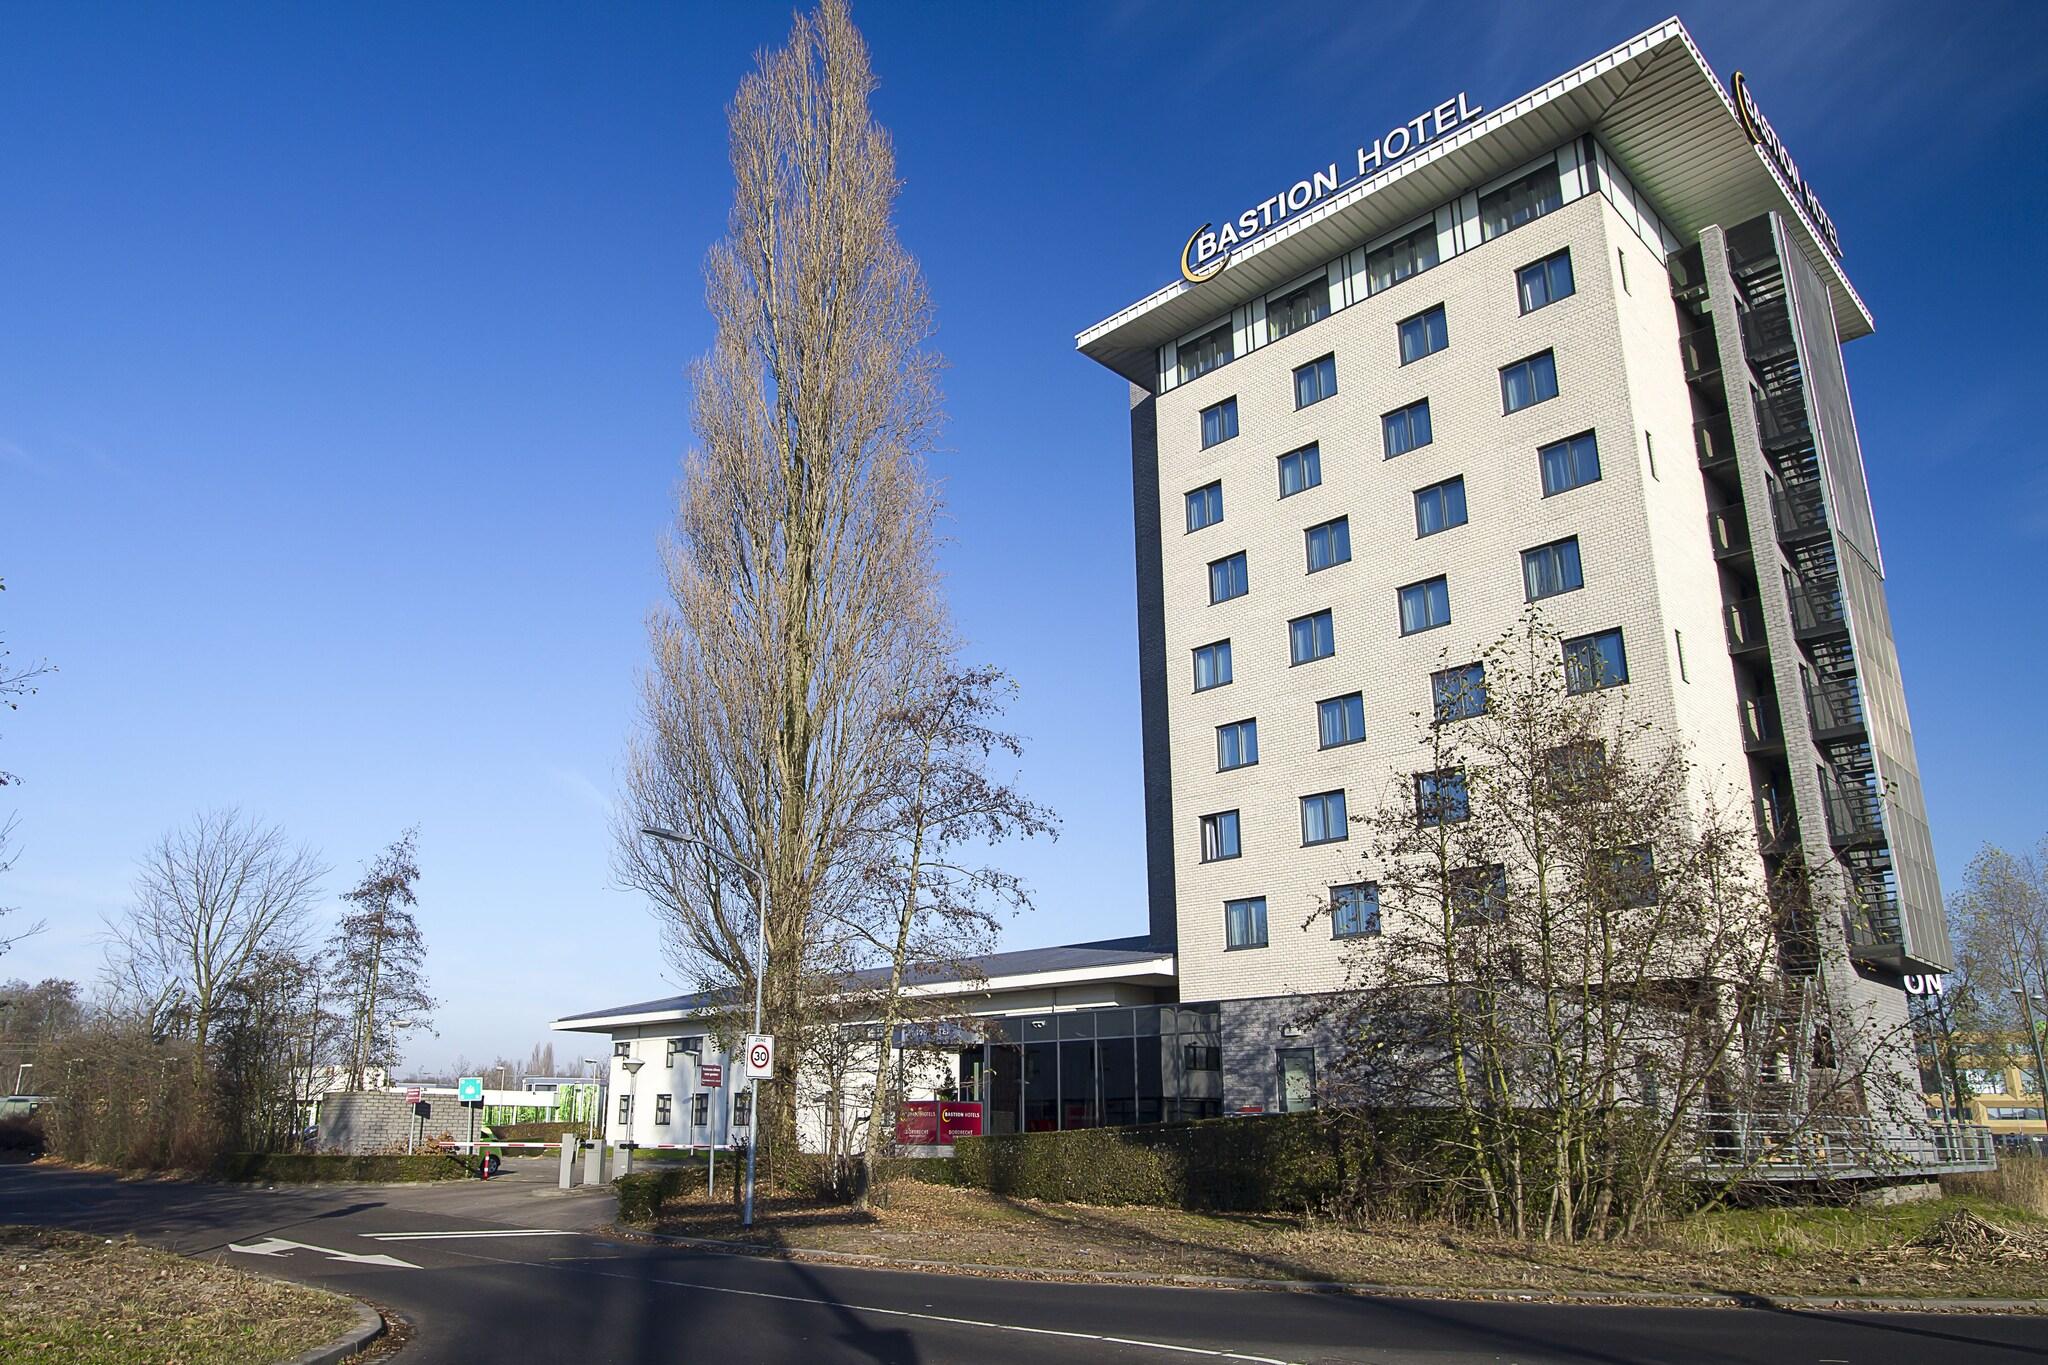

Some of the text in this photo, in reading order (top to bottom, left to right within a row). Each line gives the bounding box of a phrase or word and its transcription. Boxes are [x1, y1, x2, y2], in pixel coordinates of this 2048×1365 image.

[1197, 91, 1483, 263] BASTION HOTEL
[1742, 82, 1844, 258] BASTION HOTEL
[754, 1052, 766, 1062] 30
